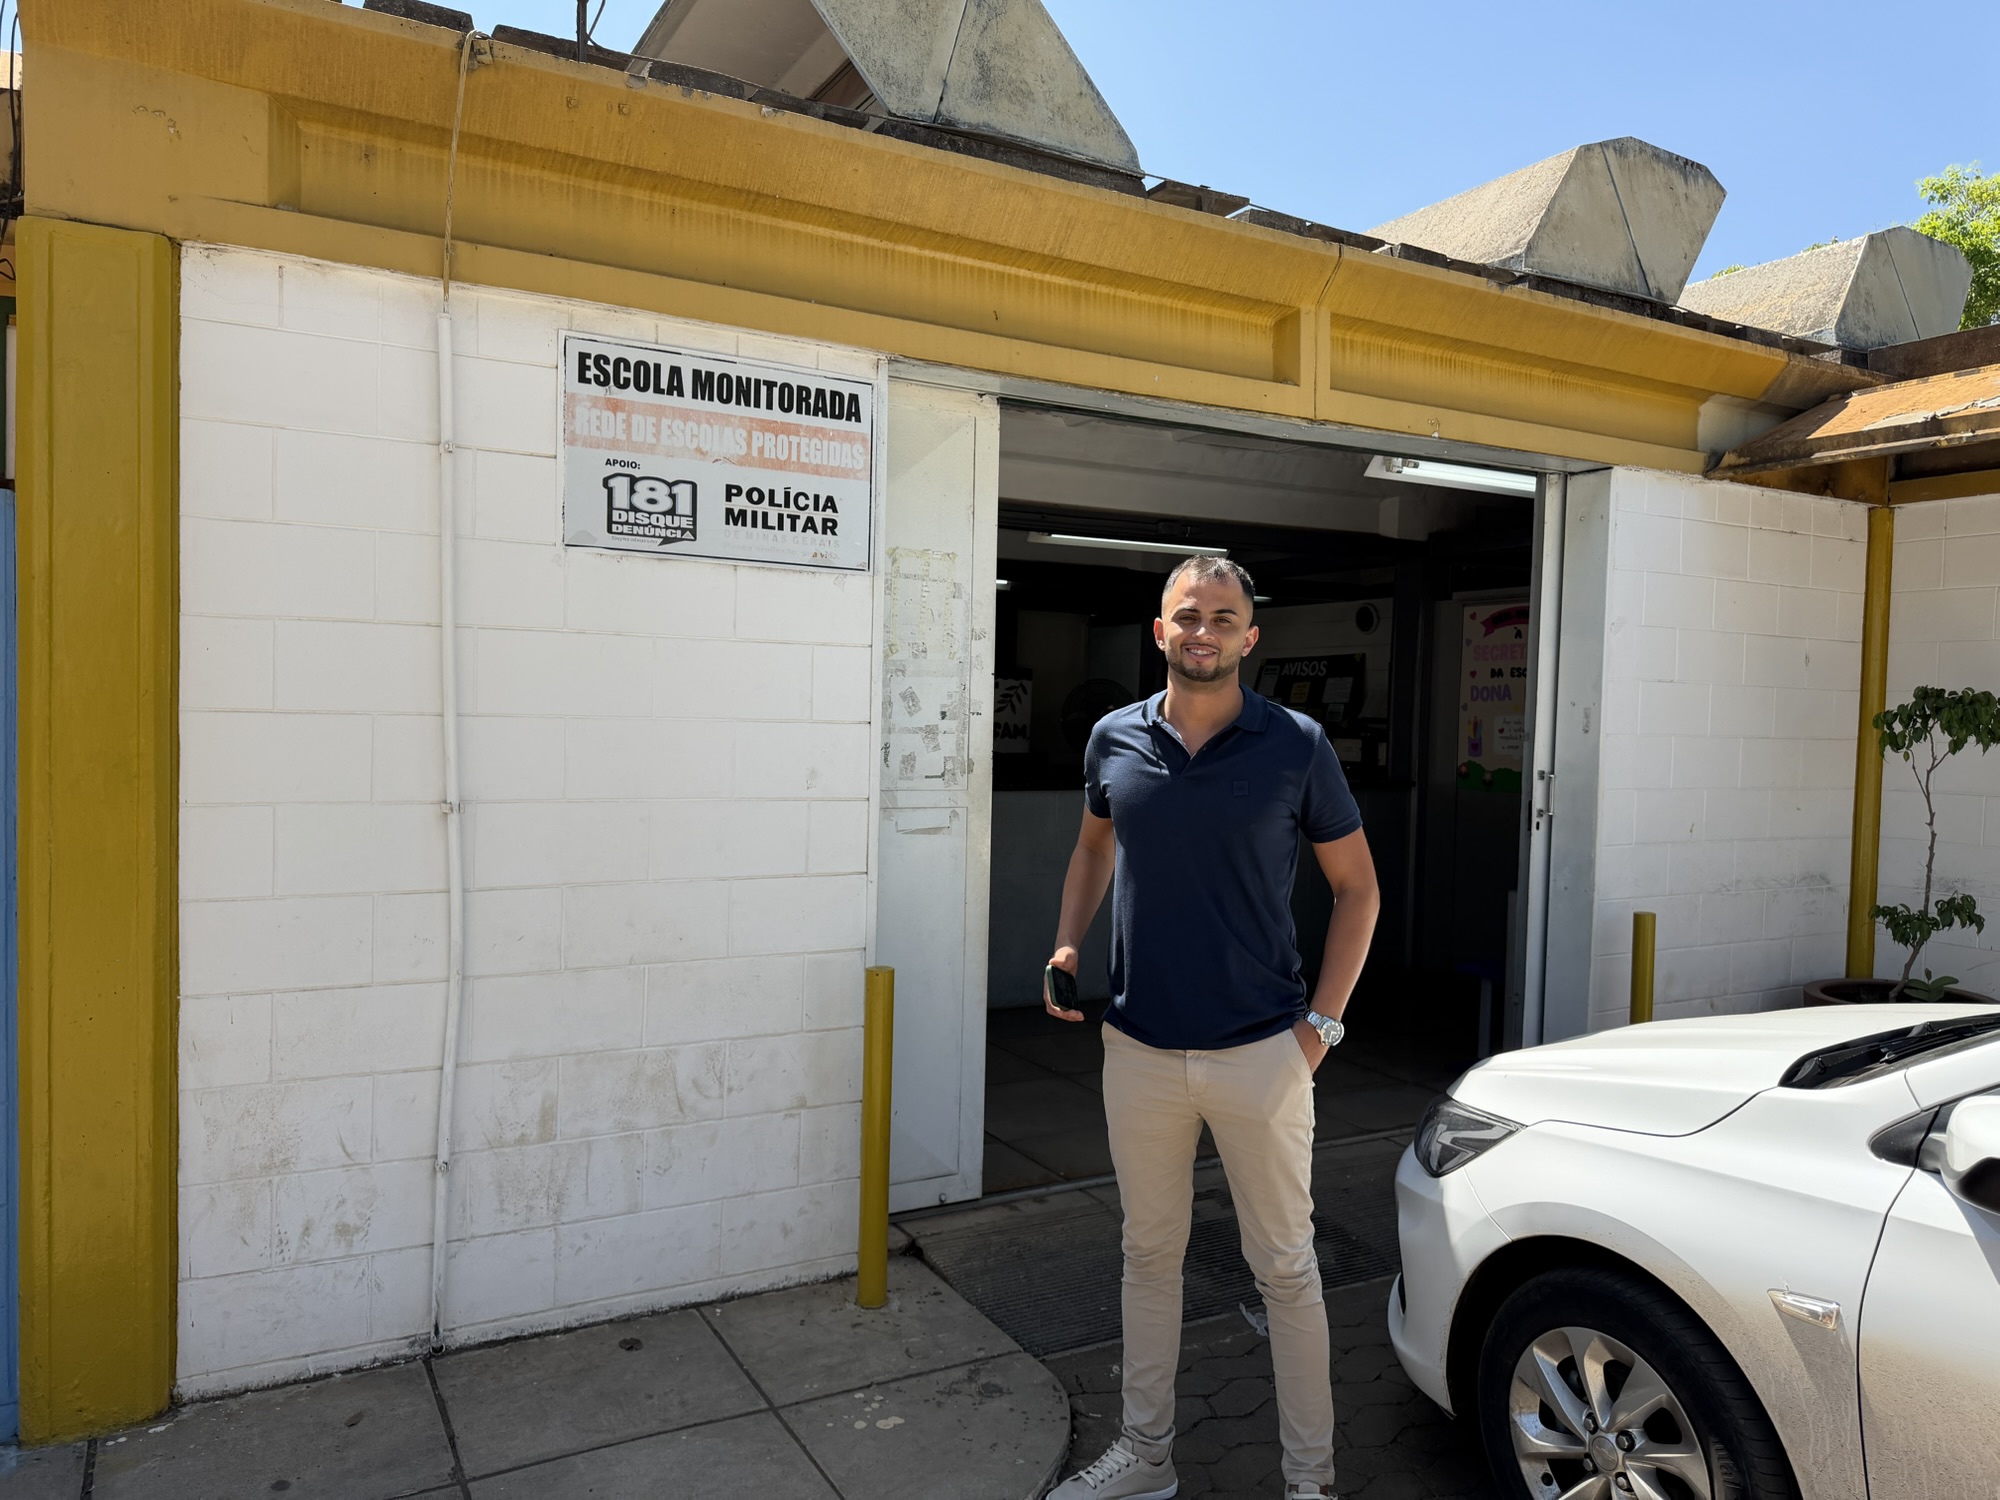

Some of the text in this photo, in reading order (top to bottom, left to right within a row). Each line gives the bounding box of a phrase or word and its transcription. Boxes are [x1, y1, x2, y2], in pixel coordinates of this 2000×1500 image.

[577, 351, 862, 423] ESCOLA MONITORADA
[575, 403, 865, 471] REDE DE ESCOLAS PROTEGIDAS
[605, 458, 641, 470] APOIO:
[607, 475, 693, 516] 181
[725, 483, 839, 514] POLÍCIA
[612, 509, 694, 529] DISQUE
[724, 507, 839, 536] MILITAR
[745, 531, 788, 543] MINAS
[792, 535, 840, 548] GERAIS
[1472, 643, 1527, 661] SECRET
[1281, 660, 1328, 677] AVISOS
[1490, 667, 1504, 679] DA
[1469, 683, 1512, 702] DONA
